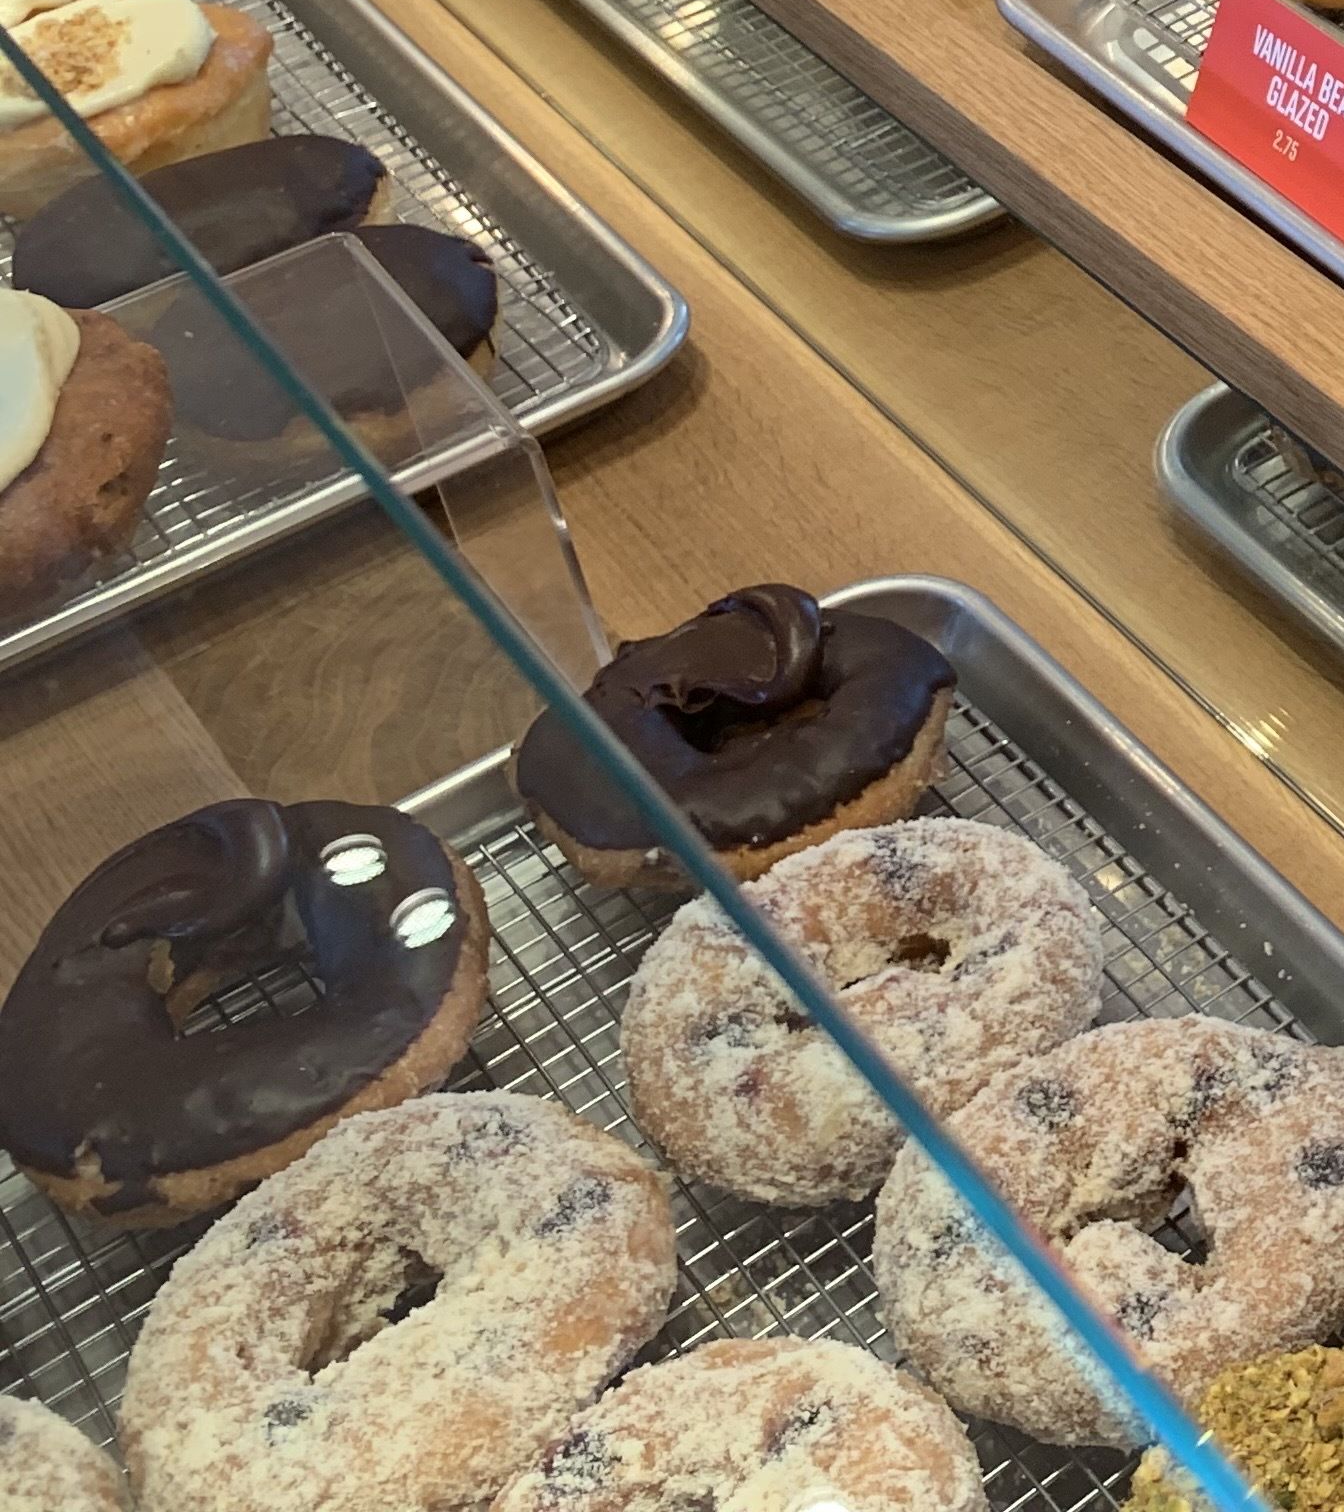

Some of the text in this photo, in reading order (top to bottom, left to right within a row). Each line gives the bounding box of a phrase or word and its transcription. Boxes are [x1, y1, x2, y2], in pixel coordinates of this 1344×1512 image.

[1253, 23, 1317, 95] VANILLA
[1266, 75, 1329, 141] GLAZED
[1272, 129, 1299, 162] 2.75
